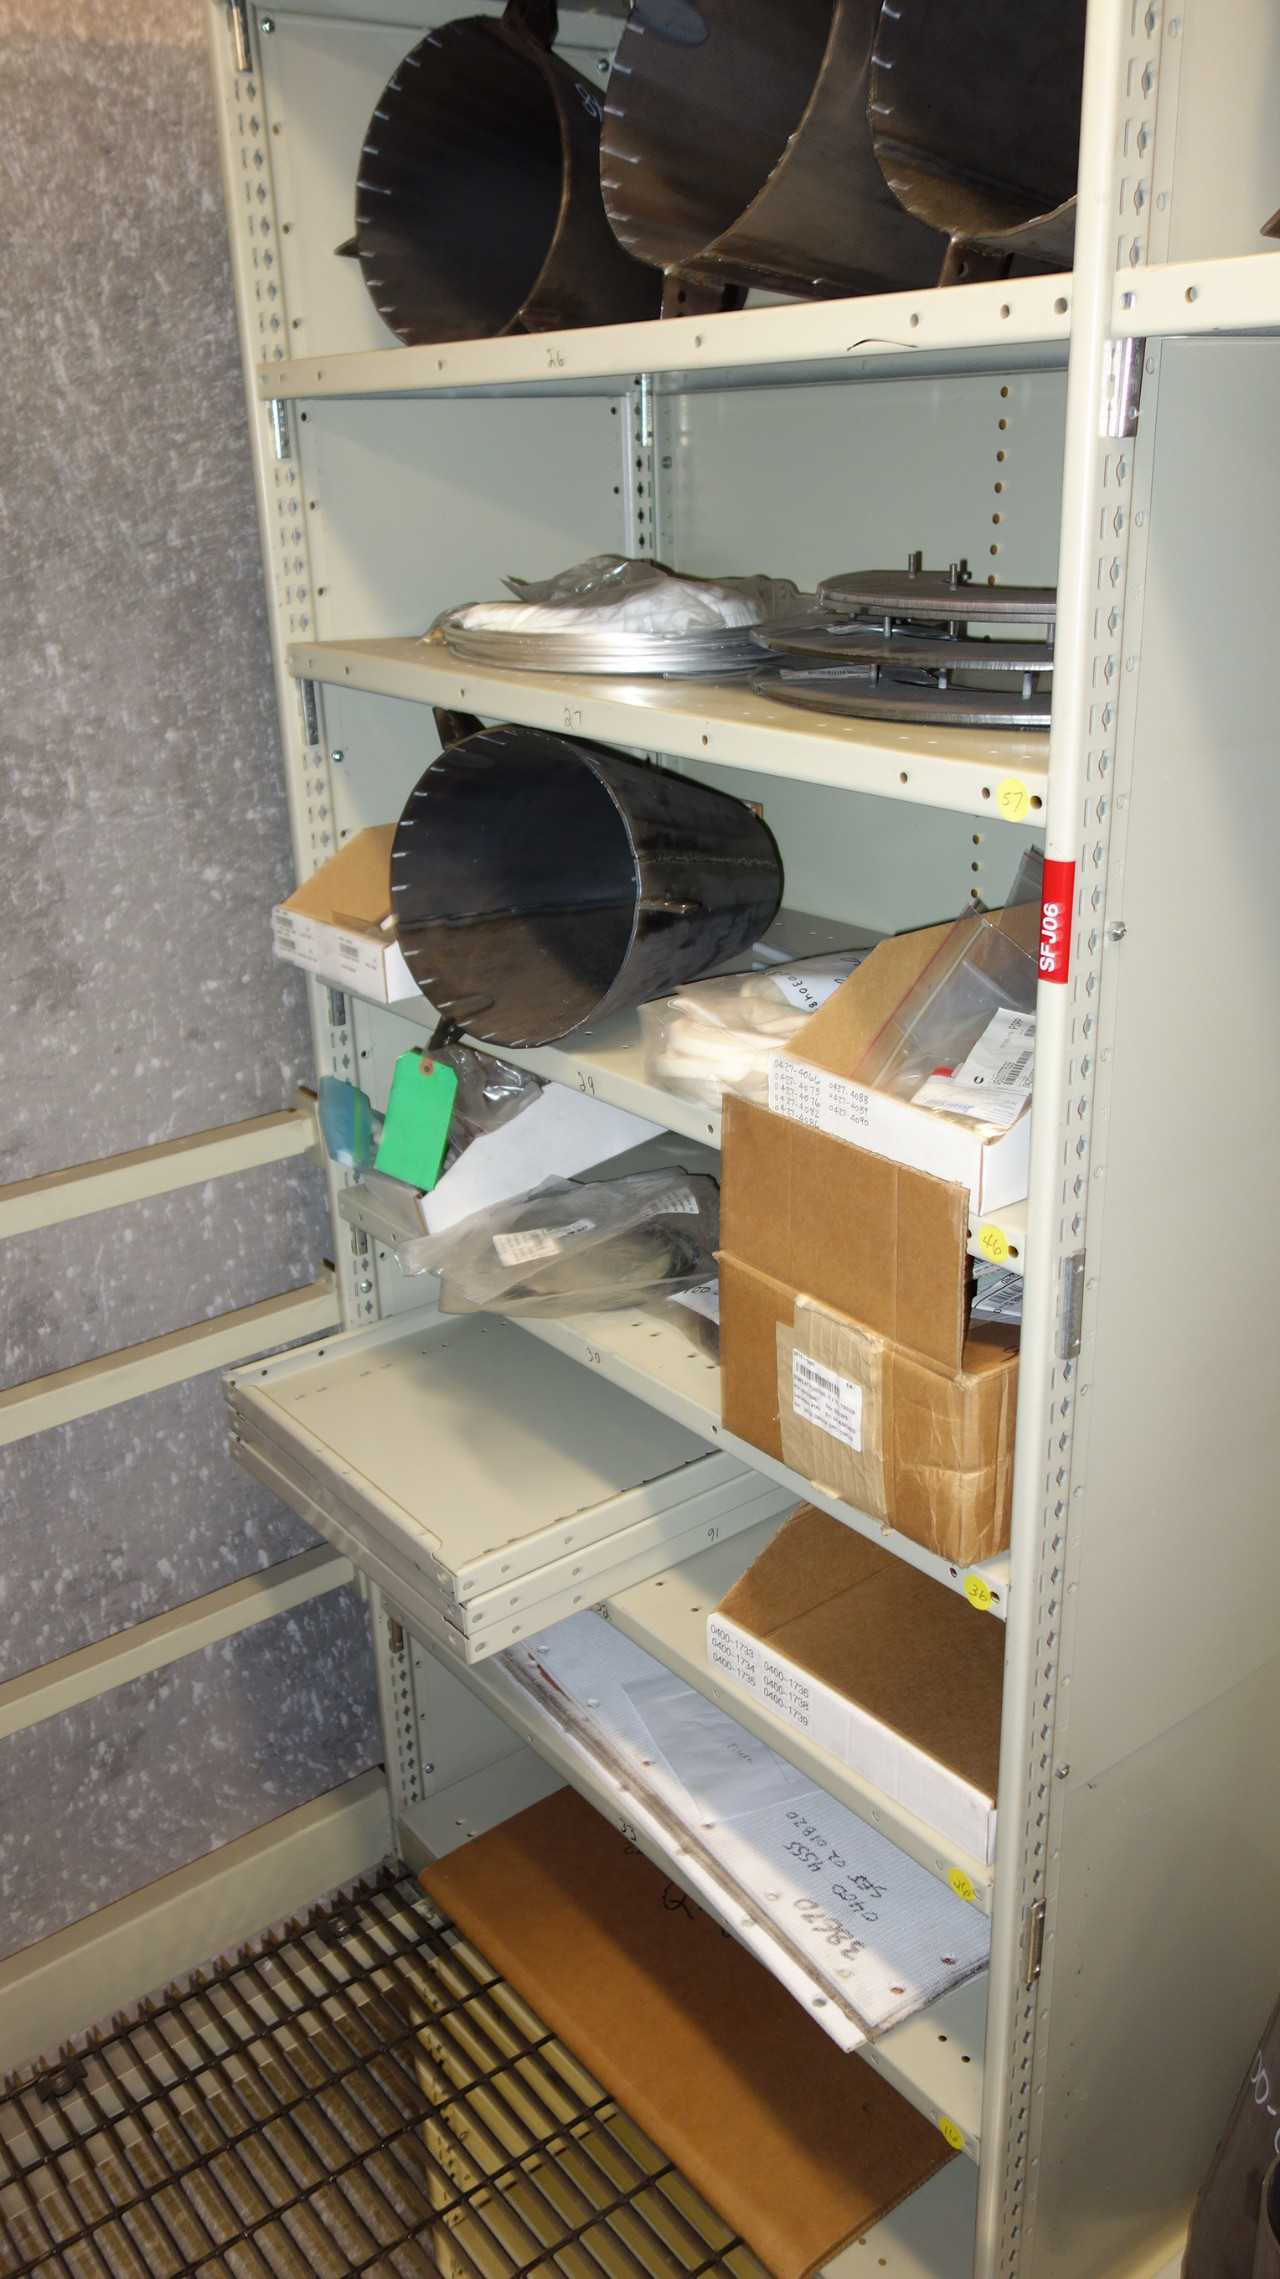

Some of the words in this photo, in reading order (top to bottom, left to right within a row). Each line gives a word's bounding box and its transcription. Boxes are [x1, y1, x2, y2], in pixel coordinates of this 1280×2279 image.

[1001, 791, 1025, 813] 57
[1040, 902, 1059, 973] SFJ06
[982, 1233, 1002, 1256] 46
[968, 1584, 989, 1602] 36
